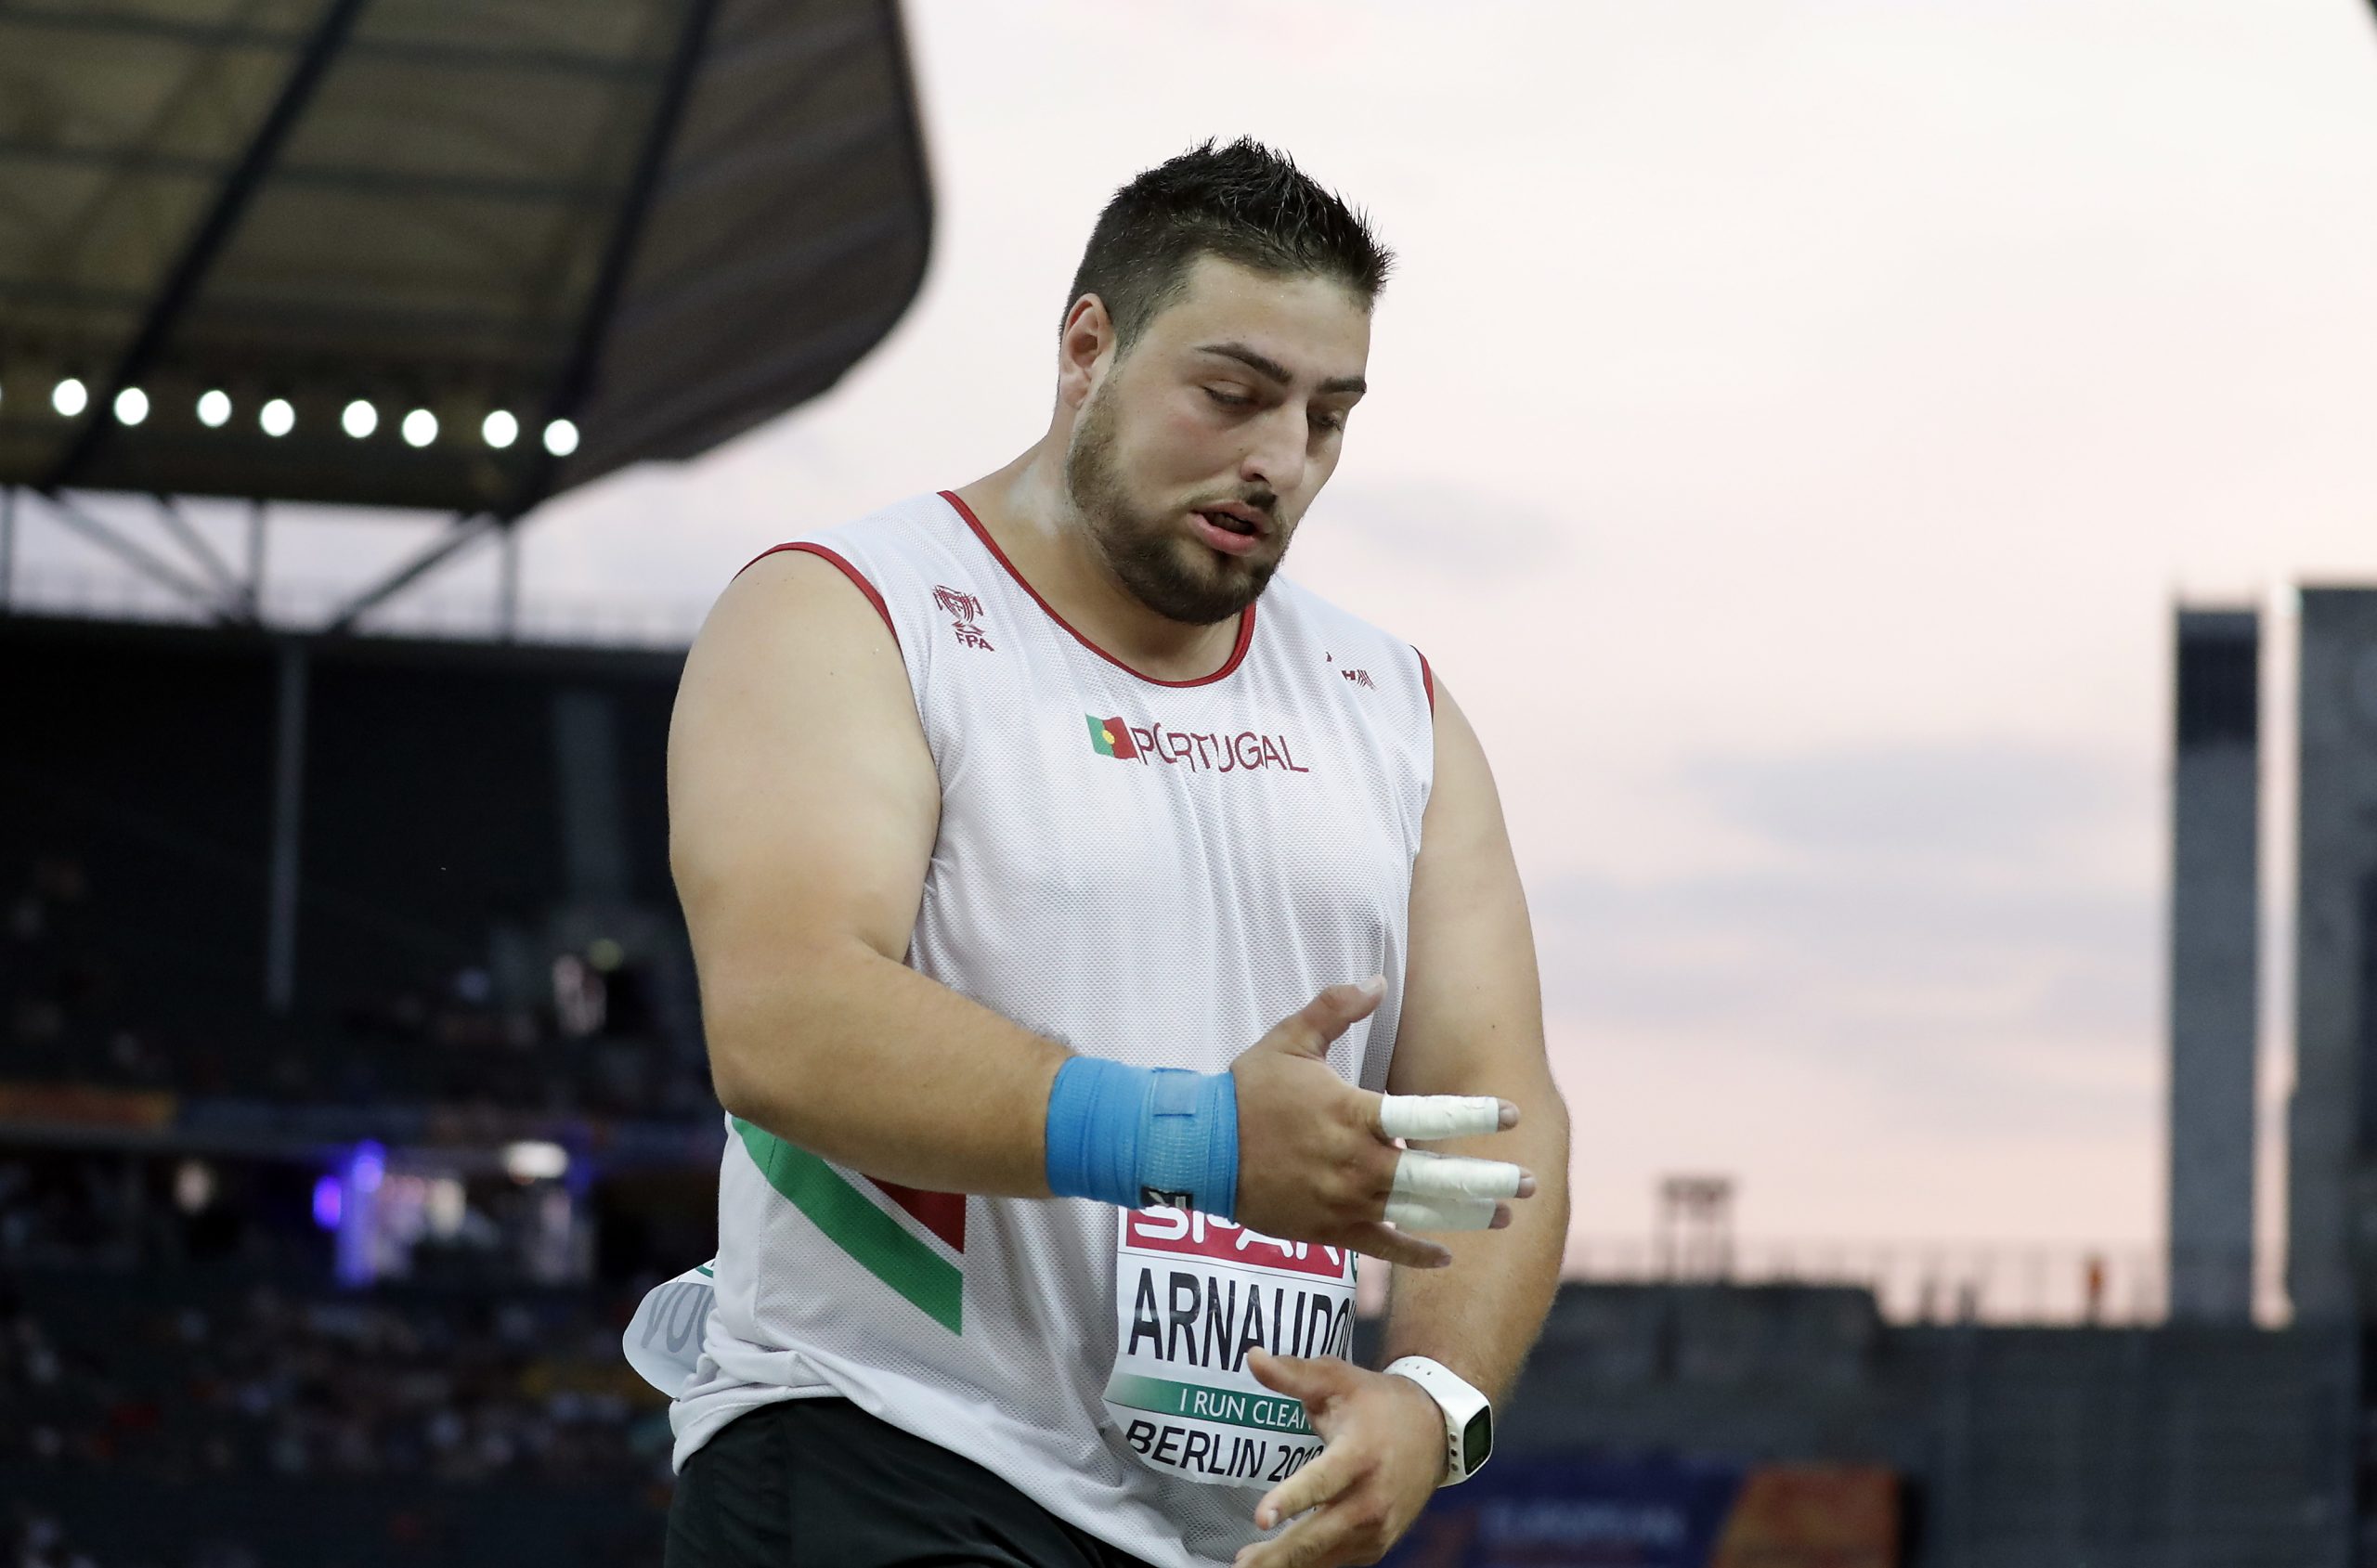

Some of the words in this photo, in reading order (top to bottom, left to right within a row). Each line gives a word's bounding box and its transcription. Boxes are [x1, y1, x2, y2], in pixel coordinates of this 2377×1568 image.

[955, 631, 994, 652] FPA
[1130, 722, 1309, 772] PORTUGAL
[1179, 1388, 1188, 1412] I
[1193, 1391, 1246, 1421] RUN
[1125, 1419, 1266, 1479] BERLIN
